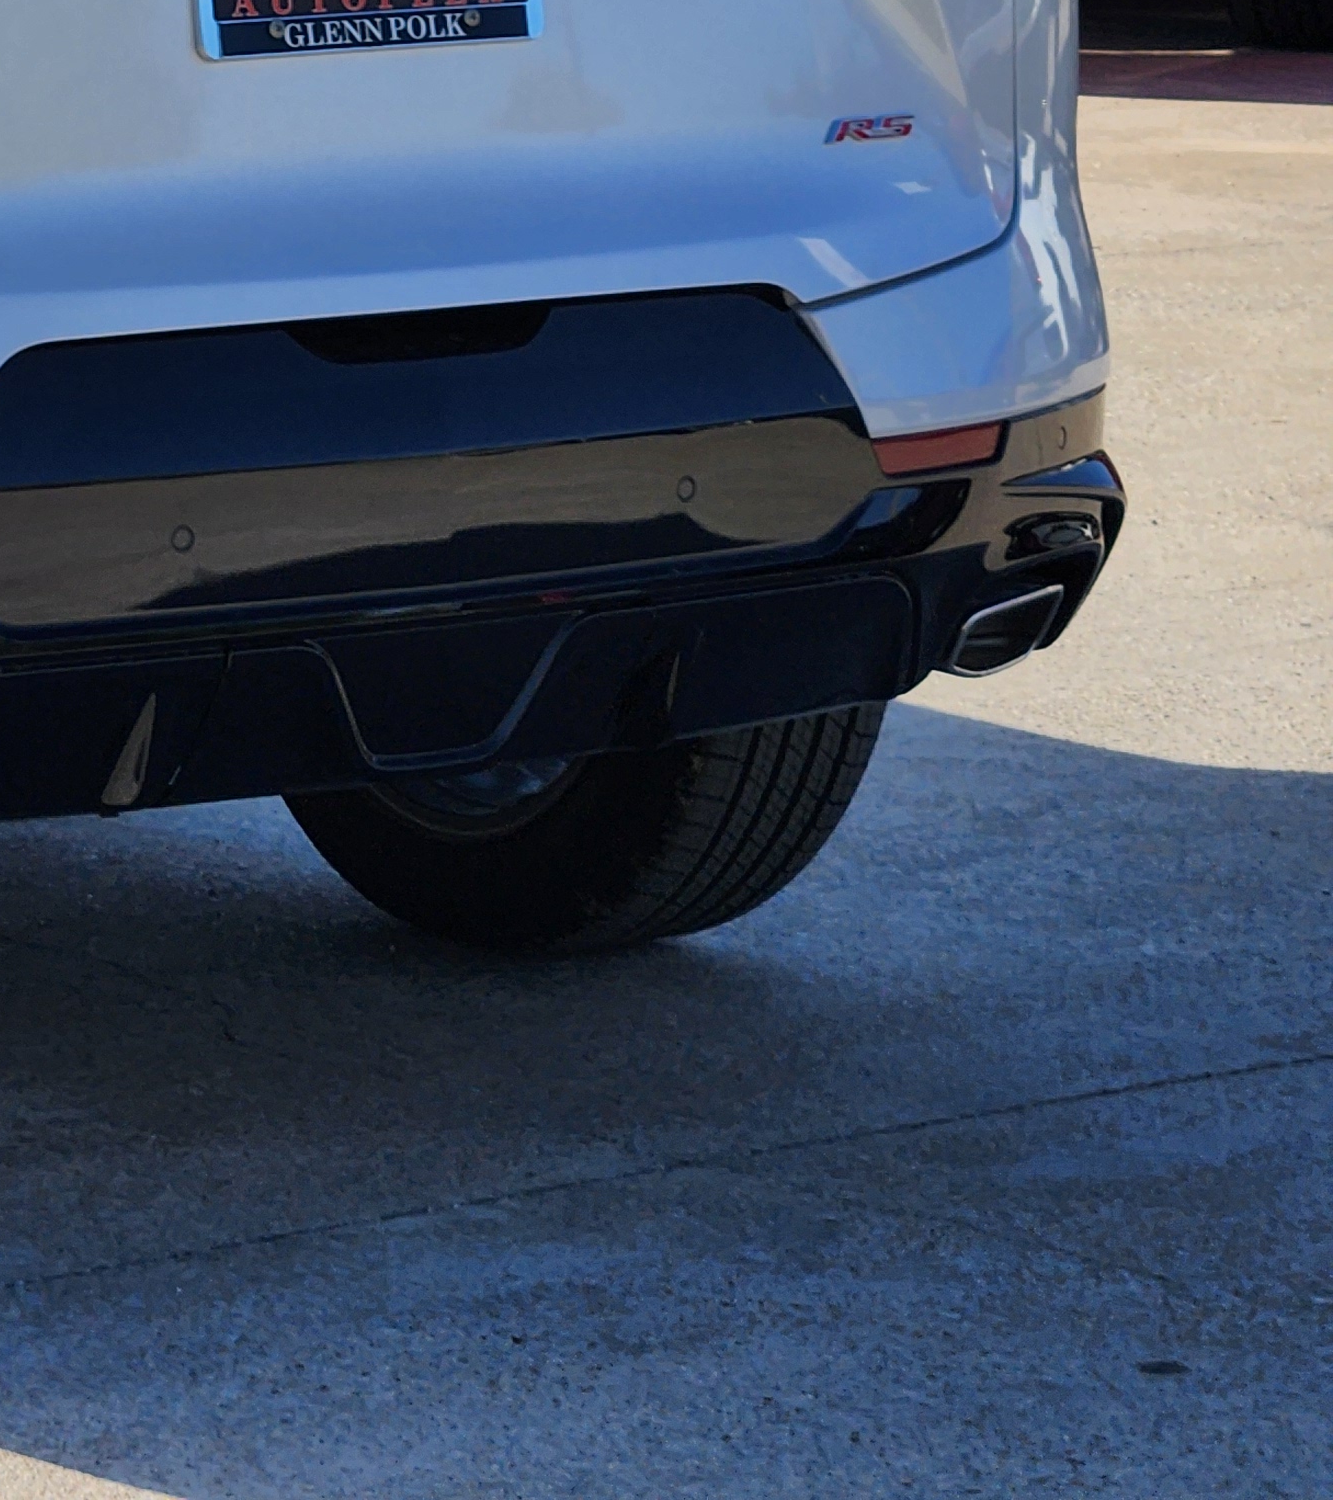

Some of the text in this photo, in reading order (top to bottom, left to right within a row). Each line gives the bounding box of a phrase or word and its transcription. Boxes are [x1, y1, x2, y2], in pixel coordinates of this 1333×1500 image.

[284, 12, 468, 48] GLENN POLK
[823, 112, 916, 145] RS
